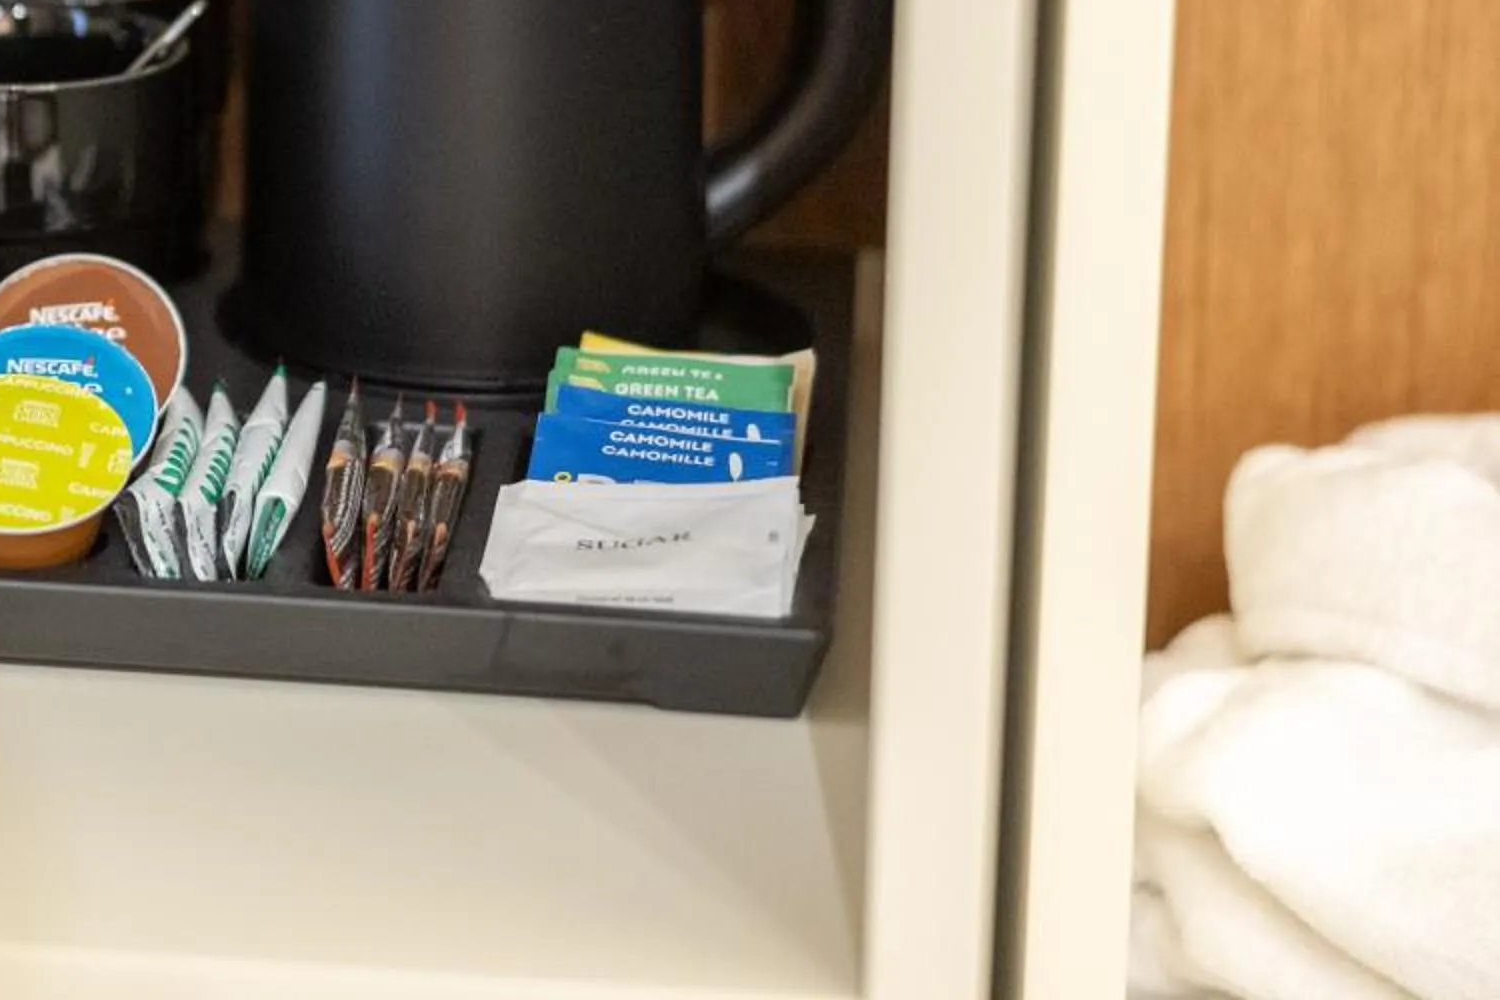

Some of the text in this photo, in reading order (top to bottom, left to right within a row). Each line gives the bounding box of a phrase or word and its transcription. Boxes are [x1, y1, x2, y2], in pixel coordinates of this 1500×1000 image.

[615, 382, 719, 401] GREEN TEA
[627, 404, 729, 424] CAMOMILE
[609, 431, 712, 452] CAMOMILE
[601, 445, 714, 467] CAMOMILLE
